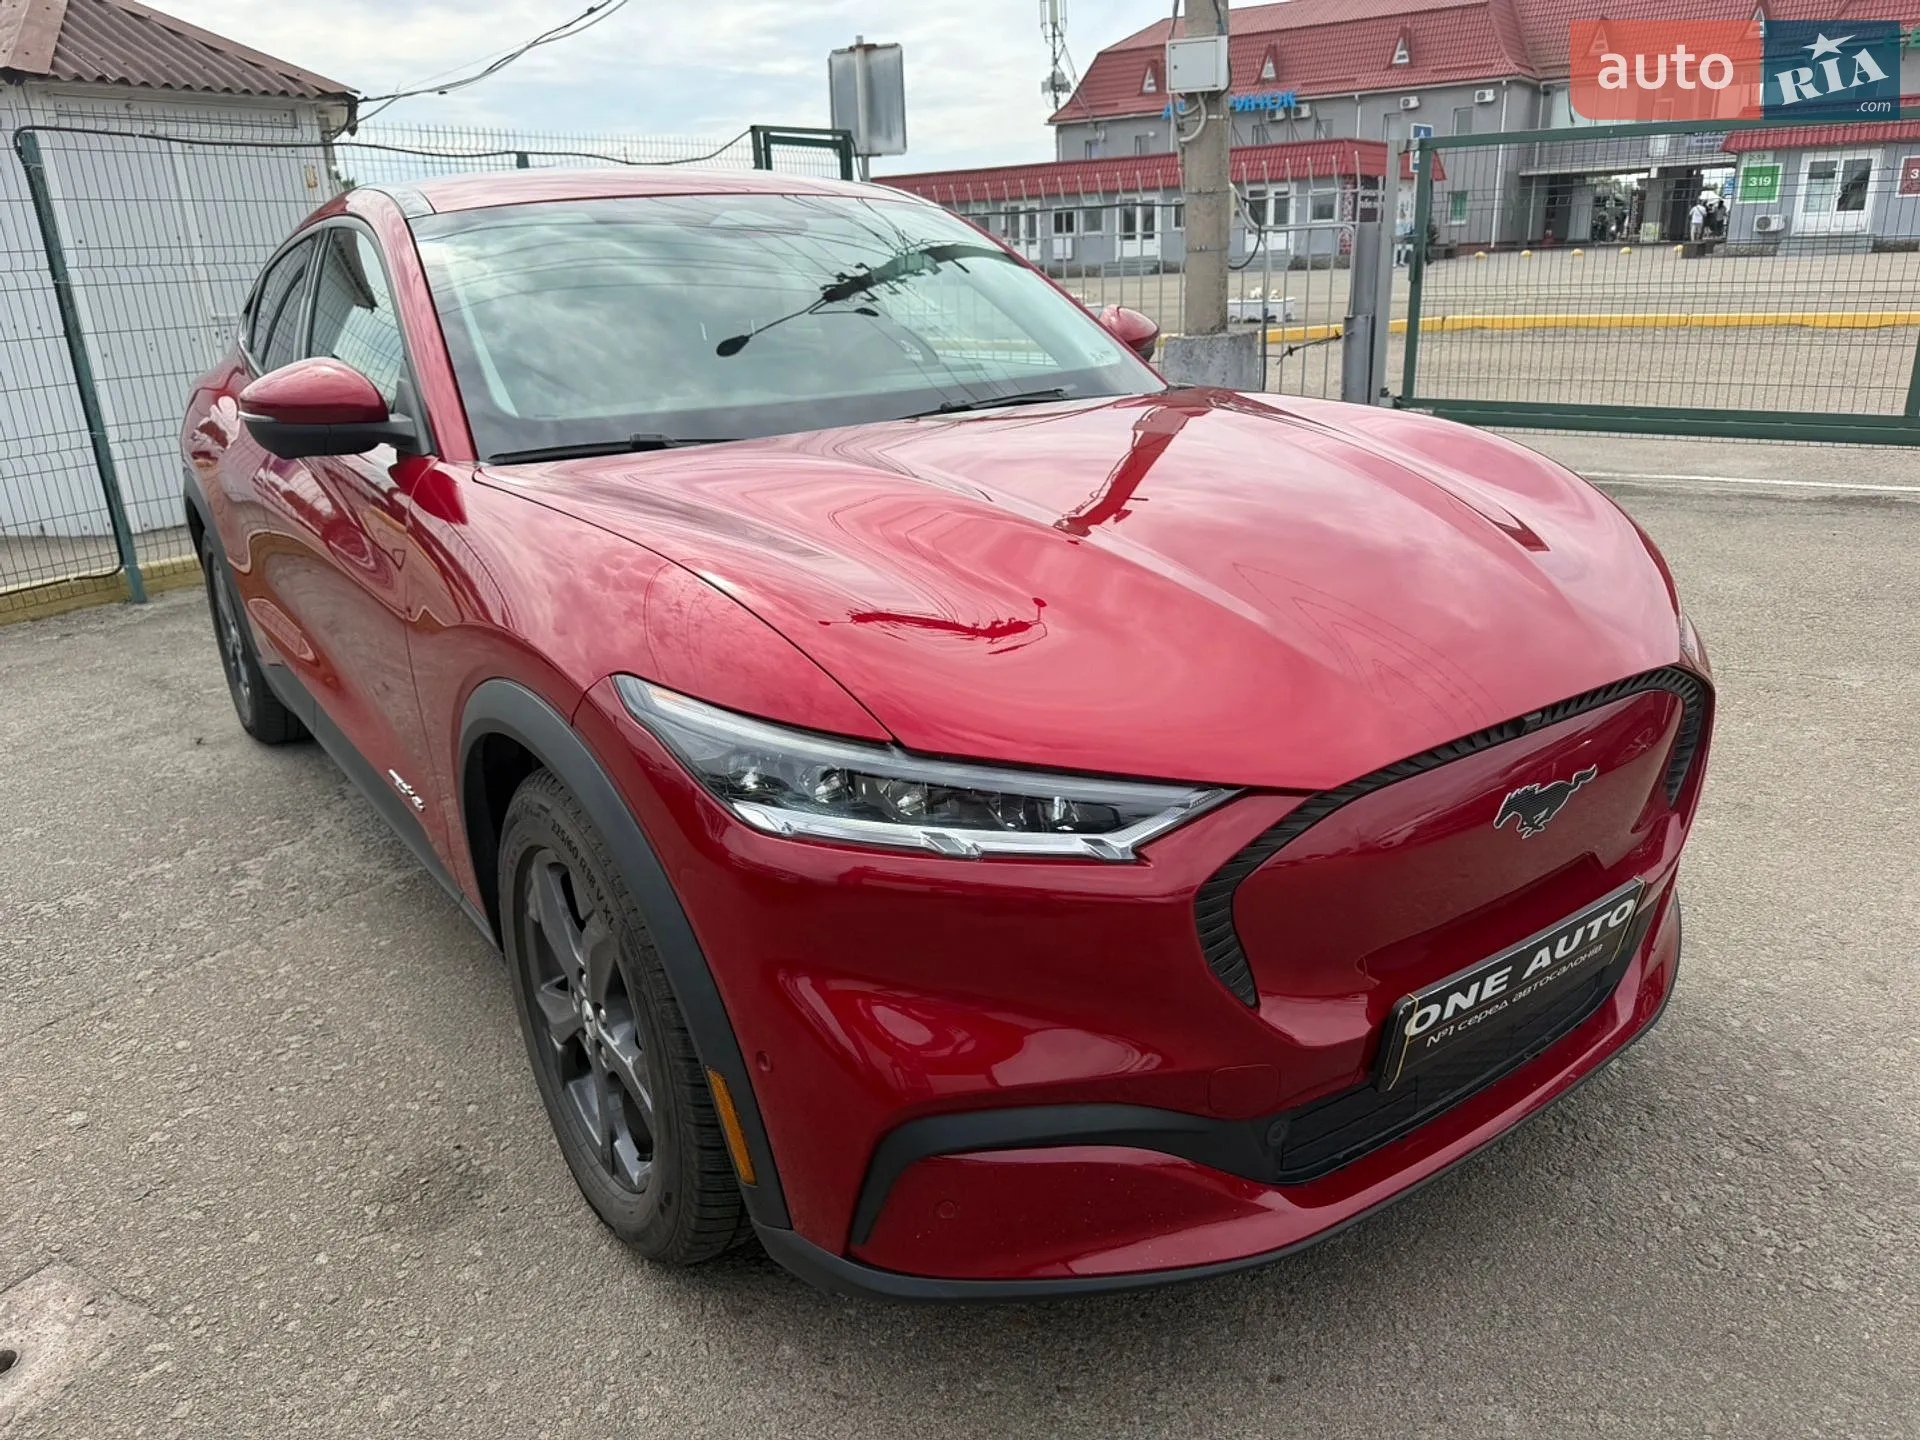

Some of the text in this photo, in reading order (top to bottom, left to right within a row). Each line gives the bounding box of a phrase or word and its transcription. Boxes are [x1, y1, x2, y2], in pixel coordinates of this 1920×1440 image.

[1749, 176, 1772, 187] 319
[1404, 898, 1635, 1036] ONE AUTO
[1457, 1000, 1509, 1032] серед
